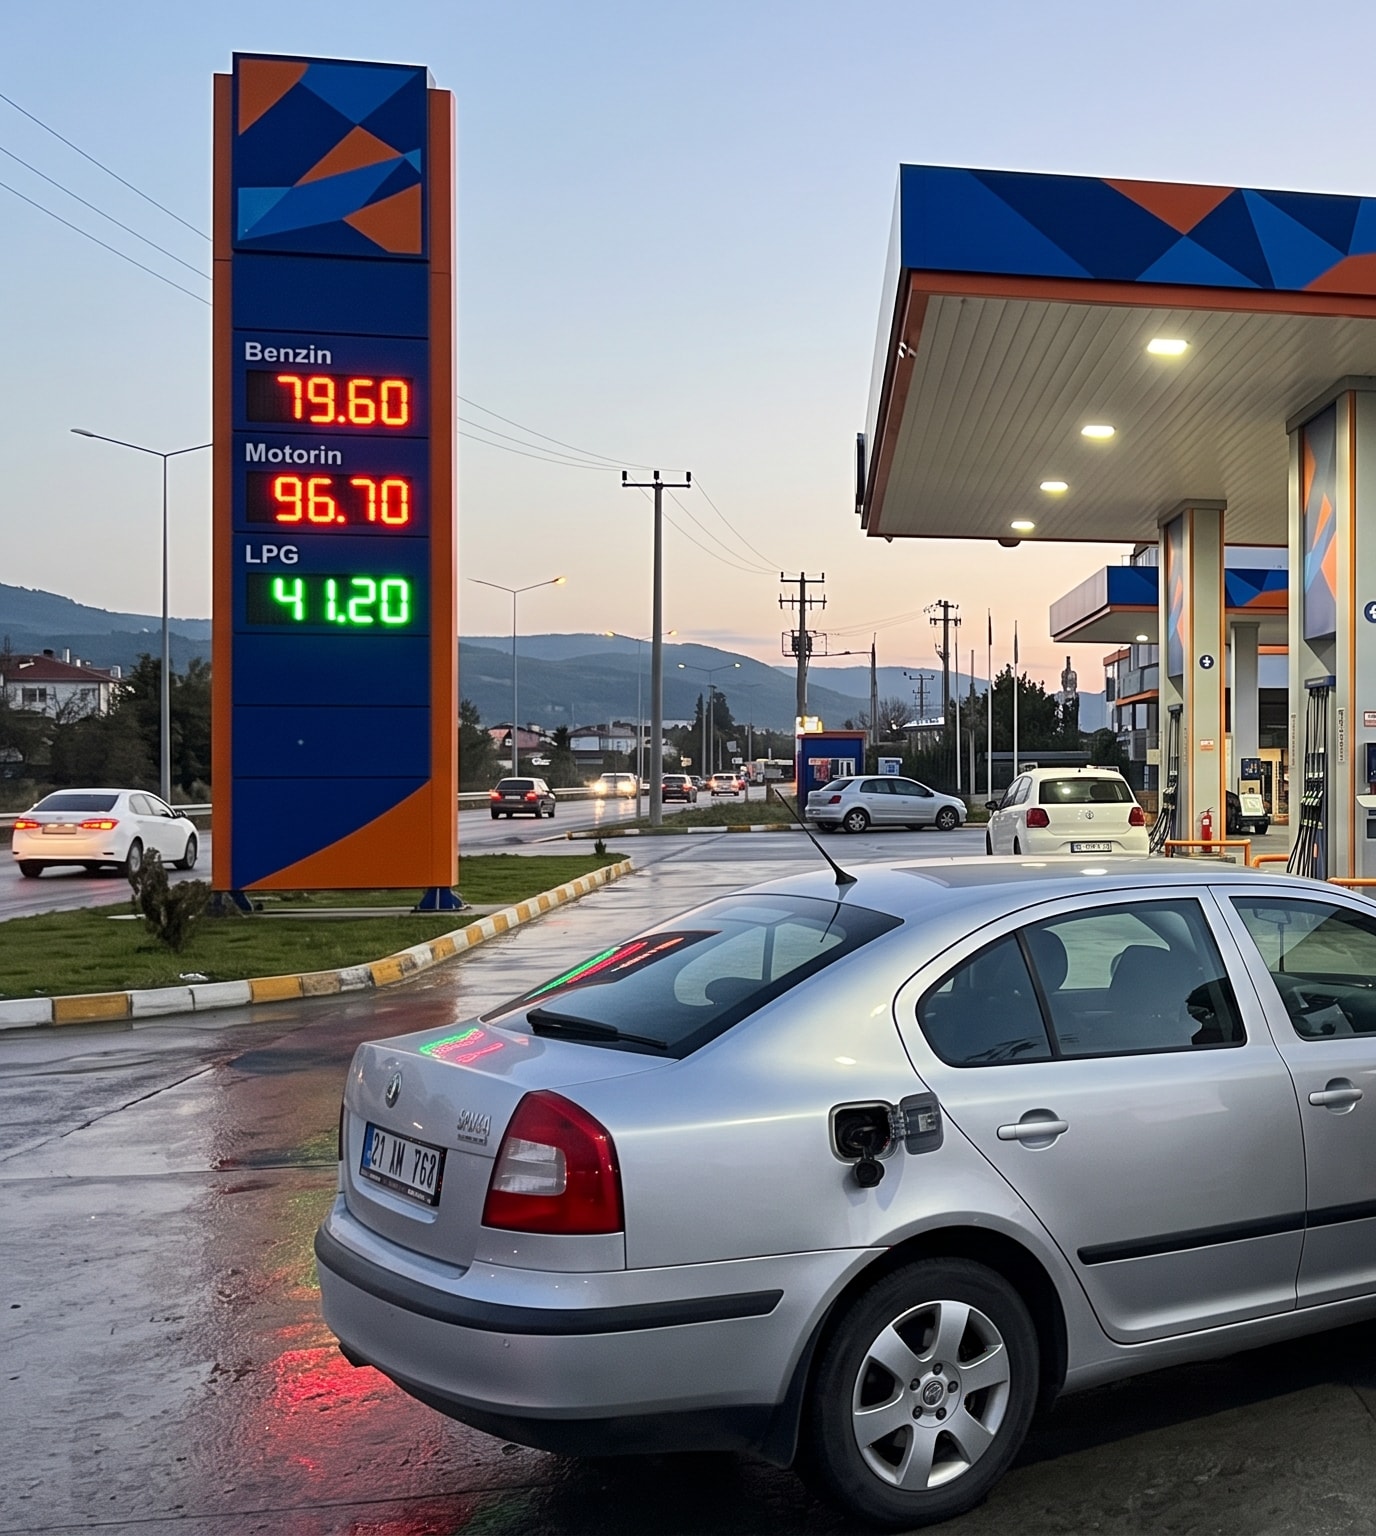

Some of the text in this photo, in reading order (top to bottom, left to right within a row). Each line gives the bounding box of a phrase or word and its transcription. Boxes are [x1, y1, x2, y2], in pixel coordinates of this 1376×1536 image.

[245, 342, 332, 364] Benzin
[277, 375, 408, 425] 79.60
[245, 443, 342, 464] Motorin
[274, 476, 409, 524] 96.70
[245, 544, 299, 564] LPG
[273, 577, 409, 624] 41.20
[371, 1132, 386, 1168] 21
